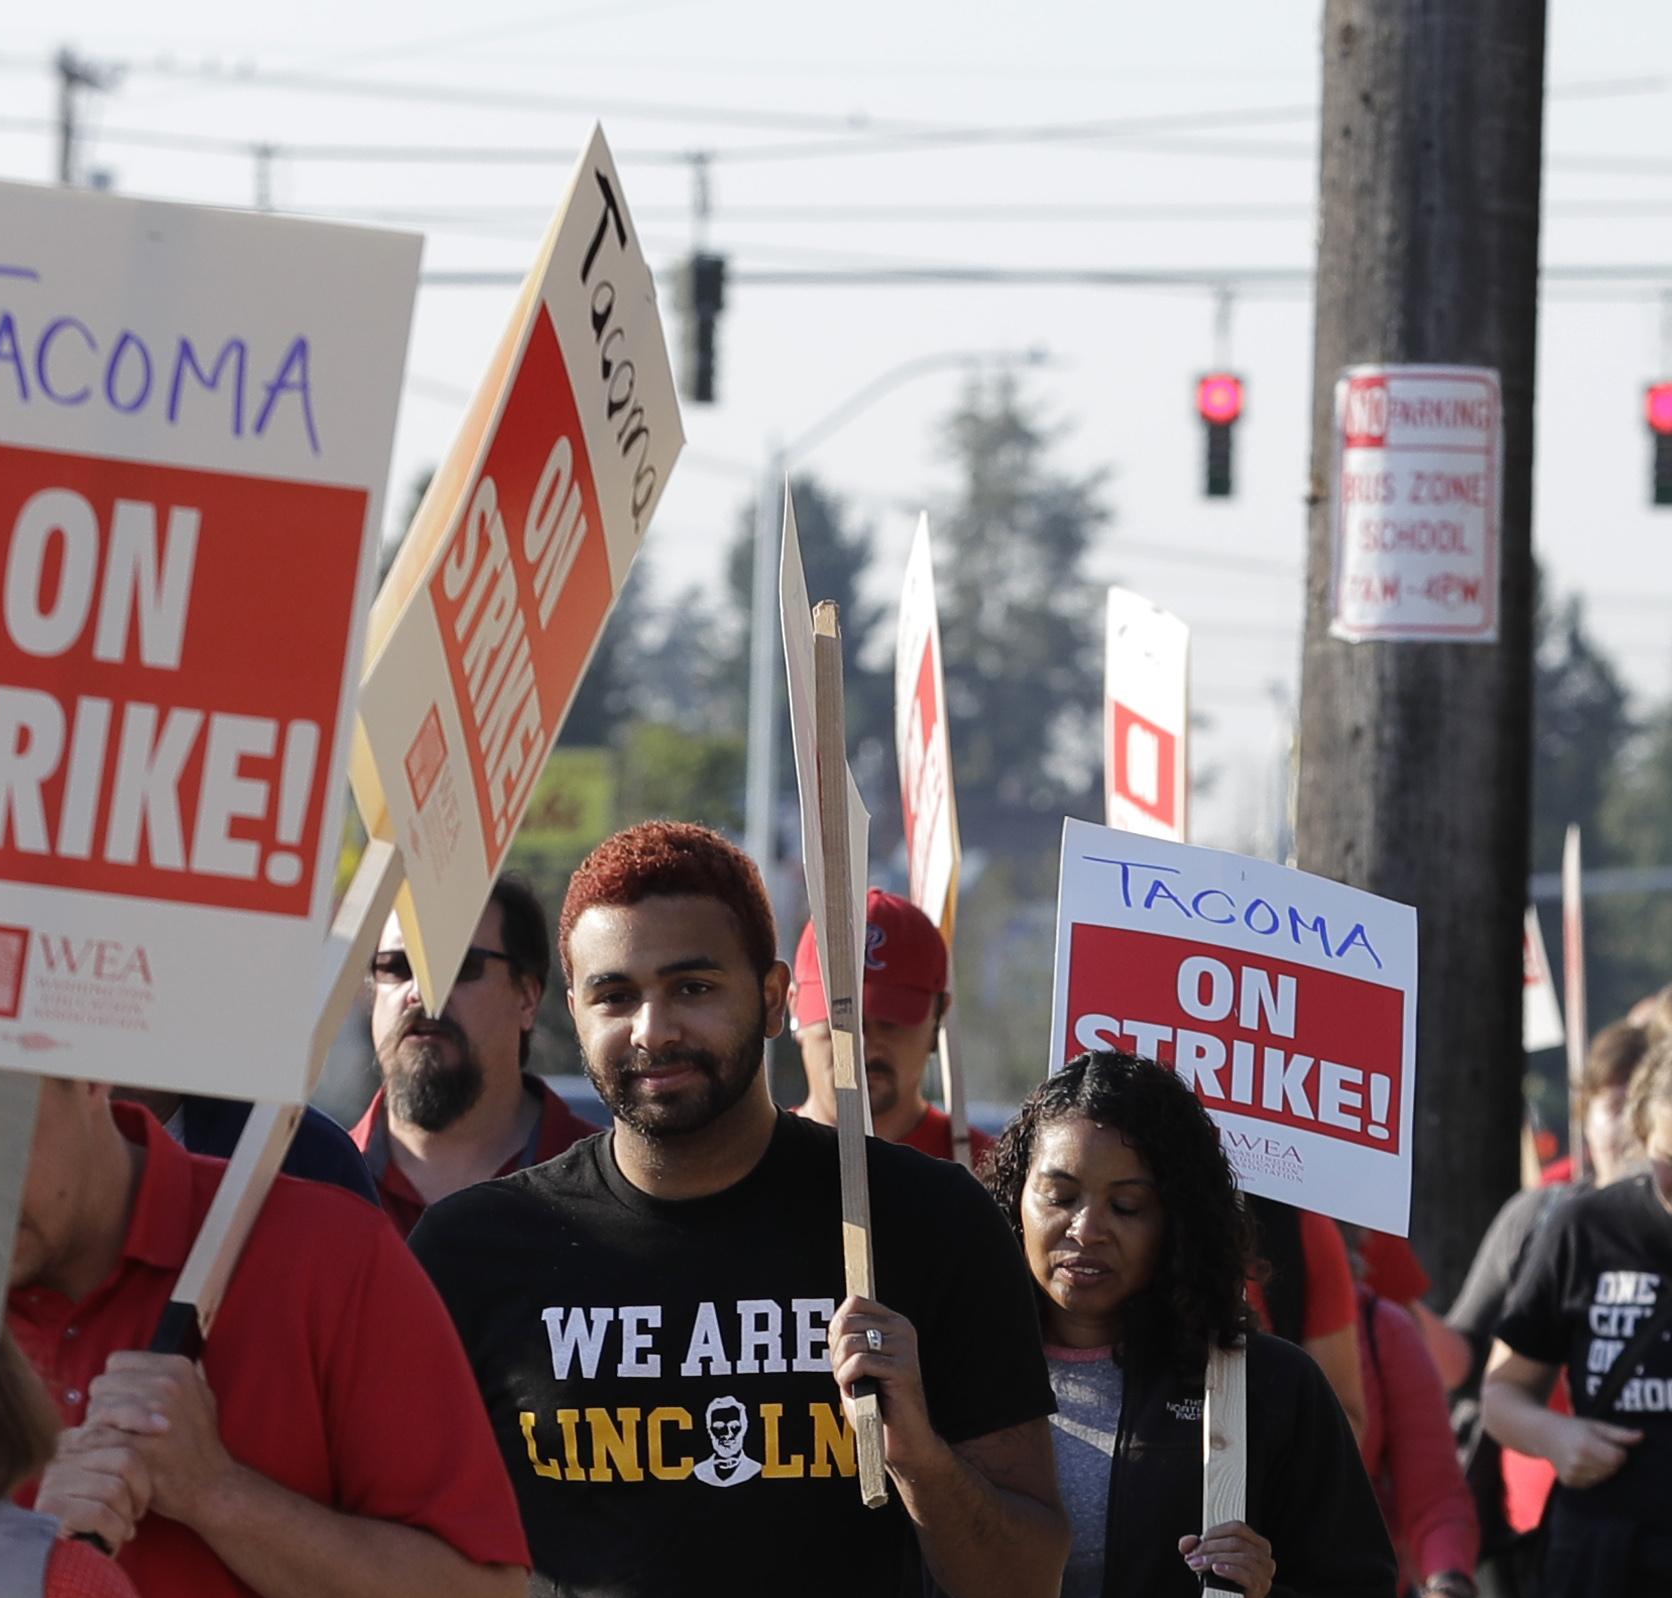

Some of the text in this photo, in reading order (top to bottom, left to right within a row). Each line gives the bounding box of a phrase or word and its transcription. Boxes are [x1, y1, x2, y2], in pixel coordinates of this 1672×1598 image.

[1410, 471, 1488, 506] ZONE
[524, 434, 588, 630] ON
[1360, 519, 1472, 556] SCHOOL
[2, 486, 202, 671] ON
[443, 475, 547, 848] STRIKE!
[1081, 855, 1384, 970] TACOMA
[39, 932, 154, 985] WEA
[1176, 955, 1298, 1040] ON
[1226, 1130, 1303, 1164] WEA
[1594, 1271, 1662, 1305] ONE
[541, 1297, 835, 1380] WE ARE
